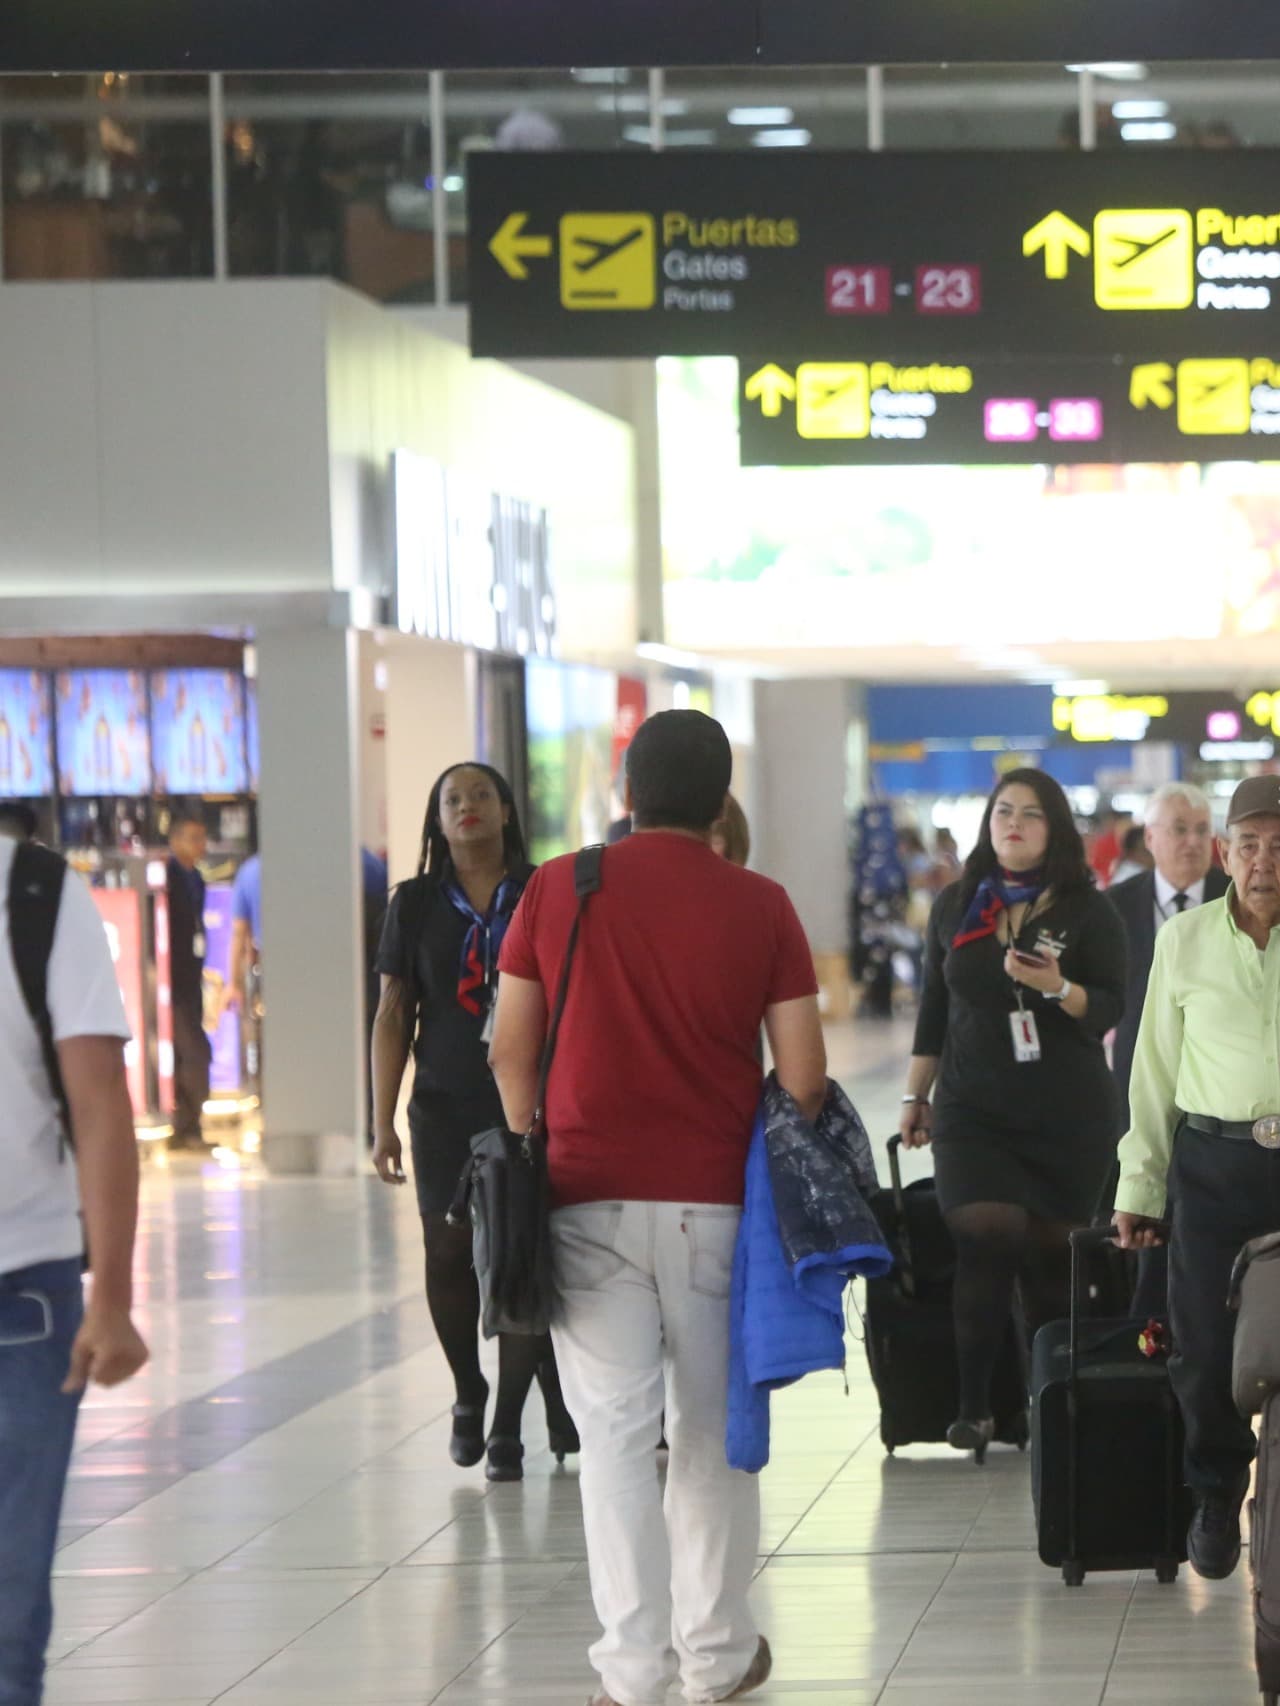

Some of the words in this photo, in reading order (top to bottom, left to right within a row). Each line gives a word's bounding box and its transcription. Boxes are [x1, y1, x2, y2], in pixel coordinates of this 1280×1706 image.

[663, 213, 798, 247] Puertas
[663, 250, 748, 281] Gates
[831, 270, 877, 307] 21
[922, 270, 974, 307] 23
